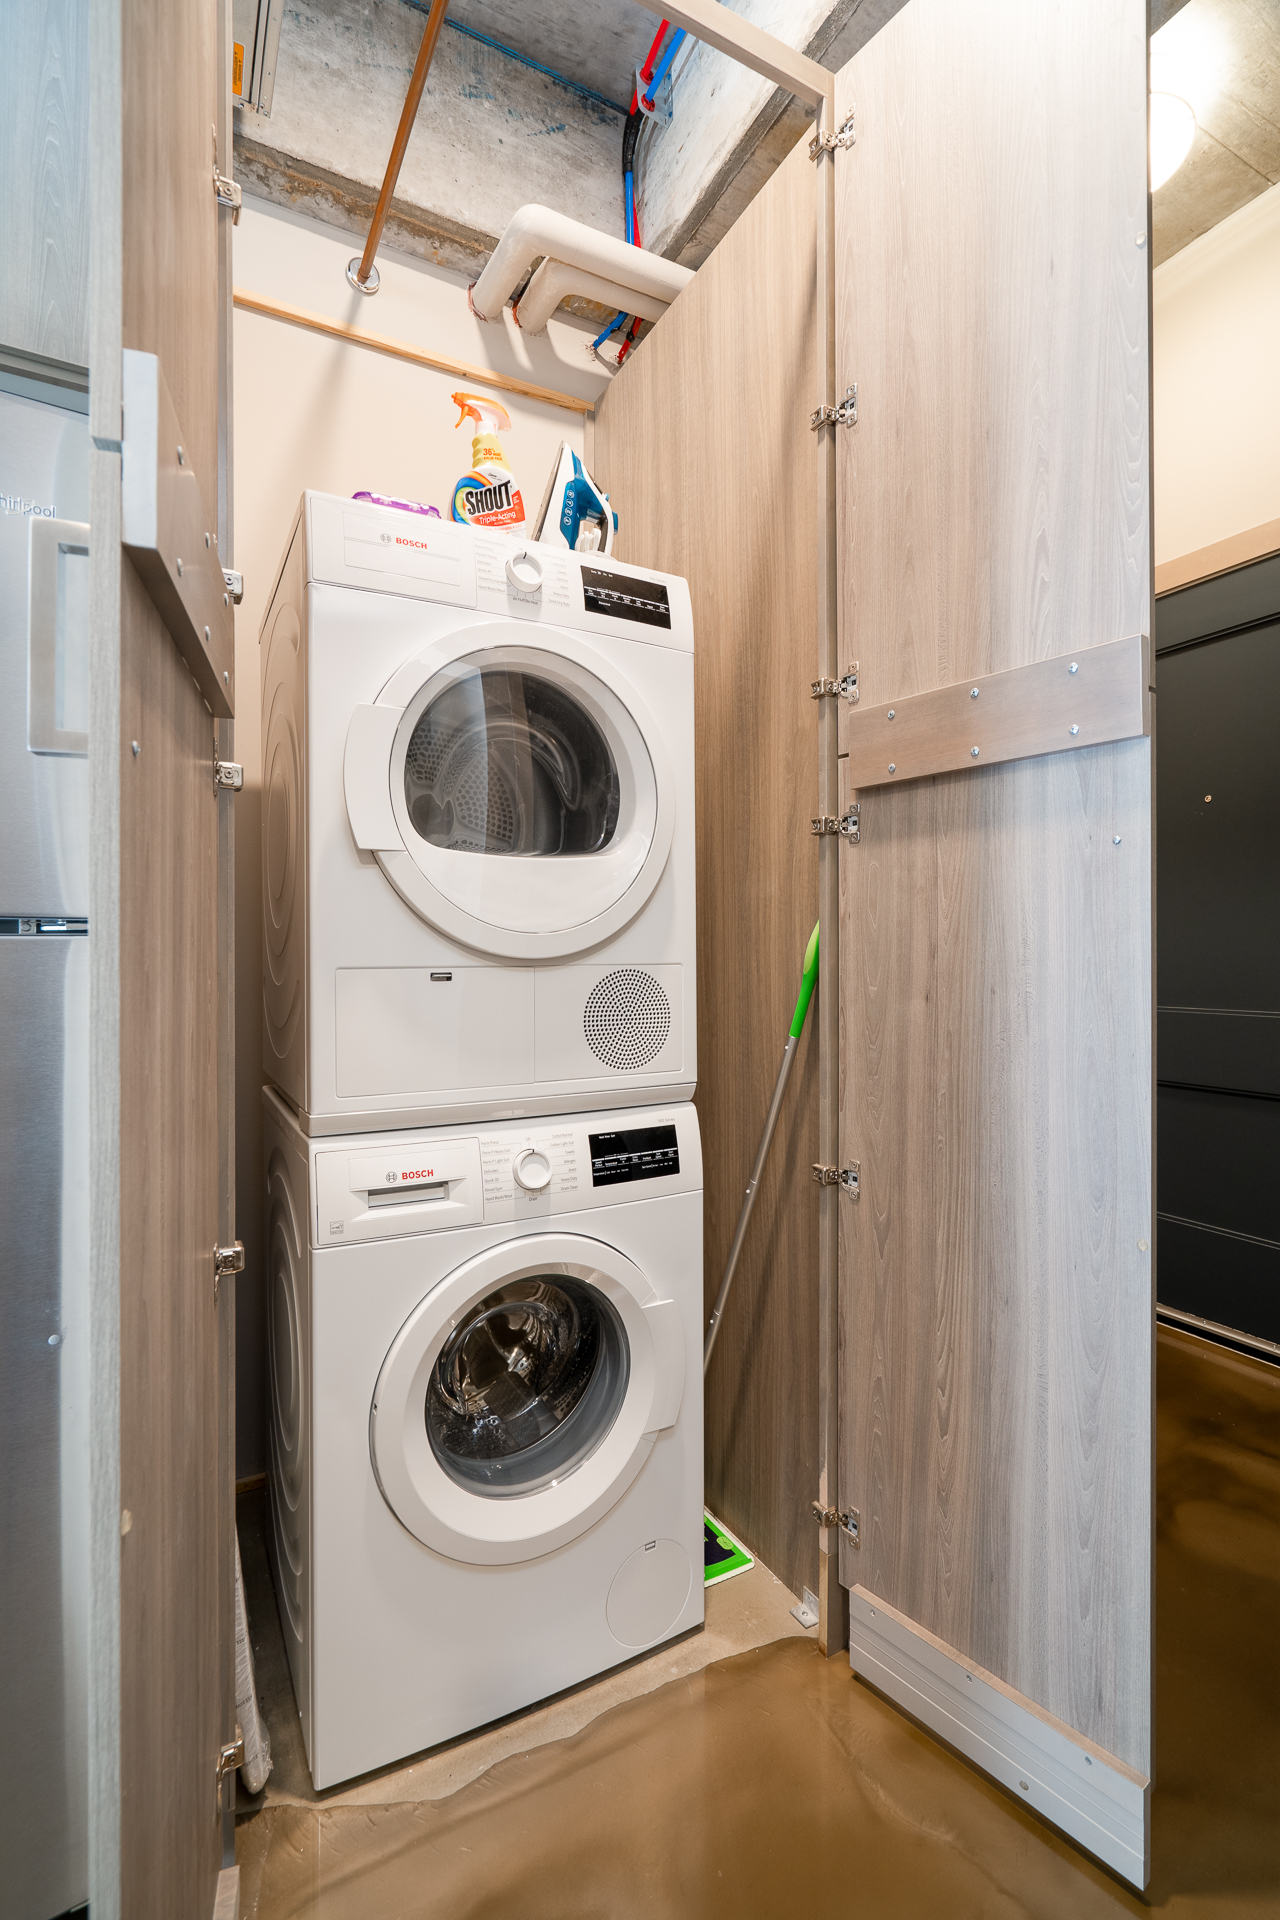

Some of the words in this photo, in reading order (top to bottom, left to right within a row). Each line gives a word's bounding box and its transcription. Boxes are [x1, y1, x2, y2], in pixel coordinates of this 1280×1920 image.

[465, 480, 511, 515] SHOUT
[479, 511, 516, 525] Triple-Acting
[395, 537, 428, 550] BOSCH
[401, 1169, 434, 1180] BOSCH
